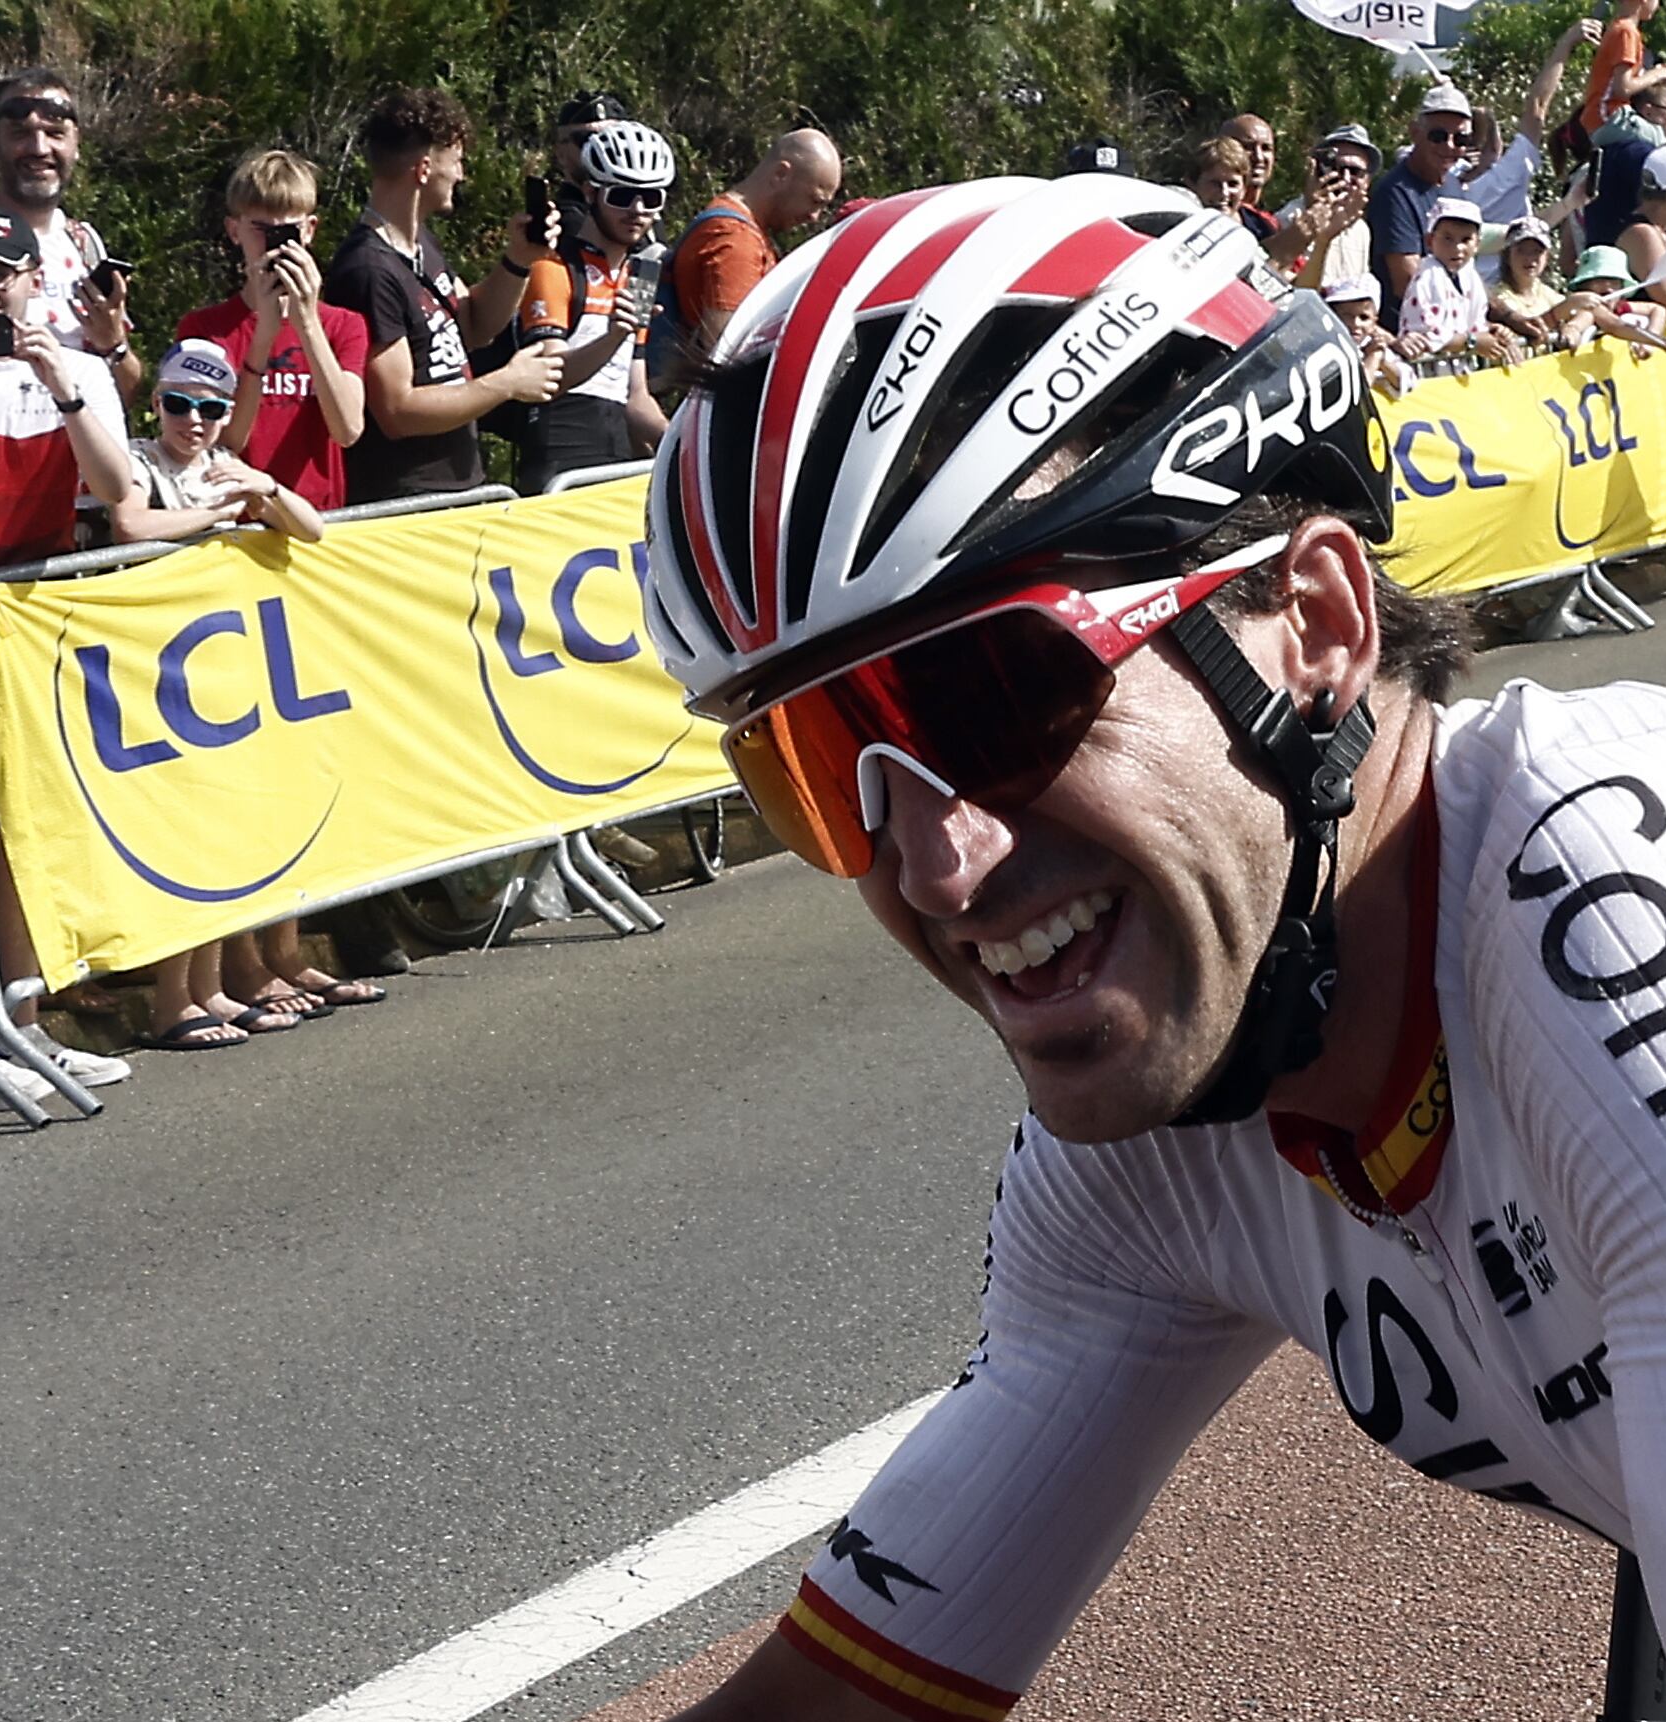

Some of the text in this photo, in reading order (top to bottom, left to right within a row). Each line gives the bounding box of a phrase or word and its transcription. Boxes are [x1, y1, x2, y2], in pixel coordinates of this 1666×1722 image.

[1007, 290, 1159, 437] Cofidis
[1543, 379, 1637, 467] LCL
[1394, 419, 1507, 502] CL
[488, 541, 647, 677] LC
[75, 597, 351, 772] LCL
